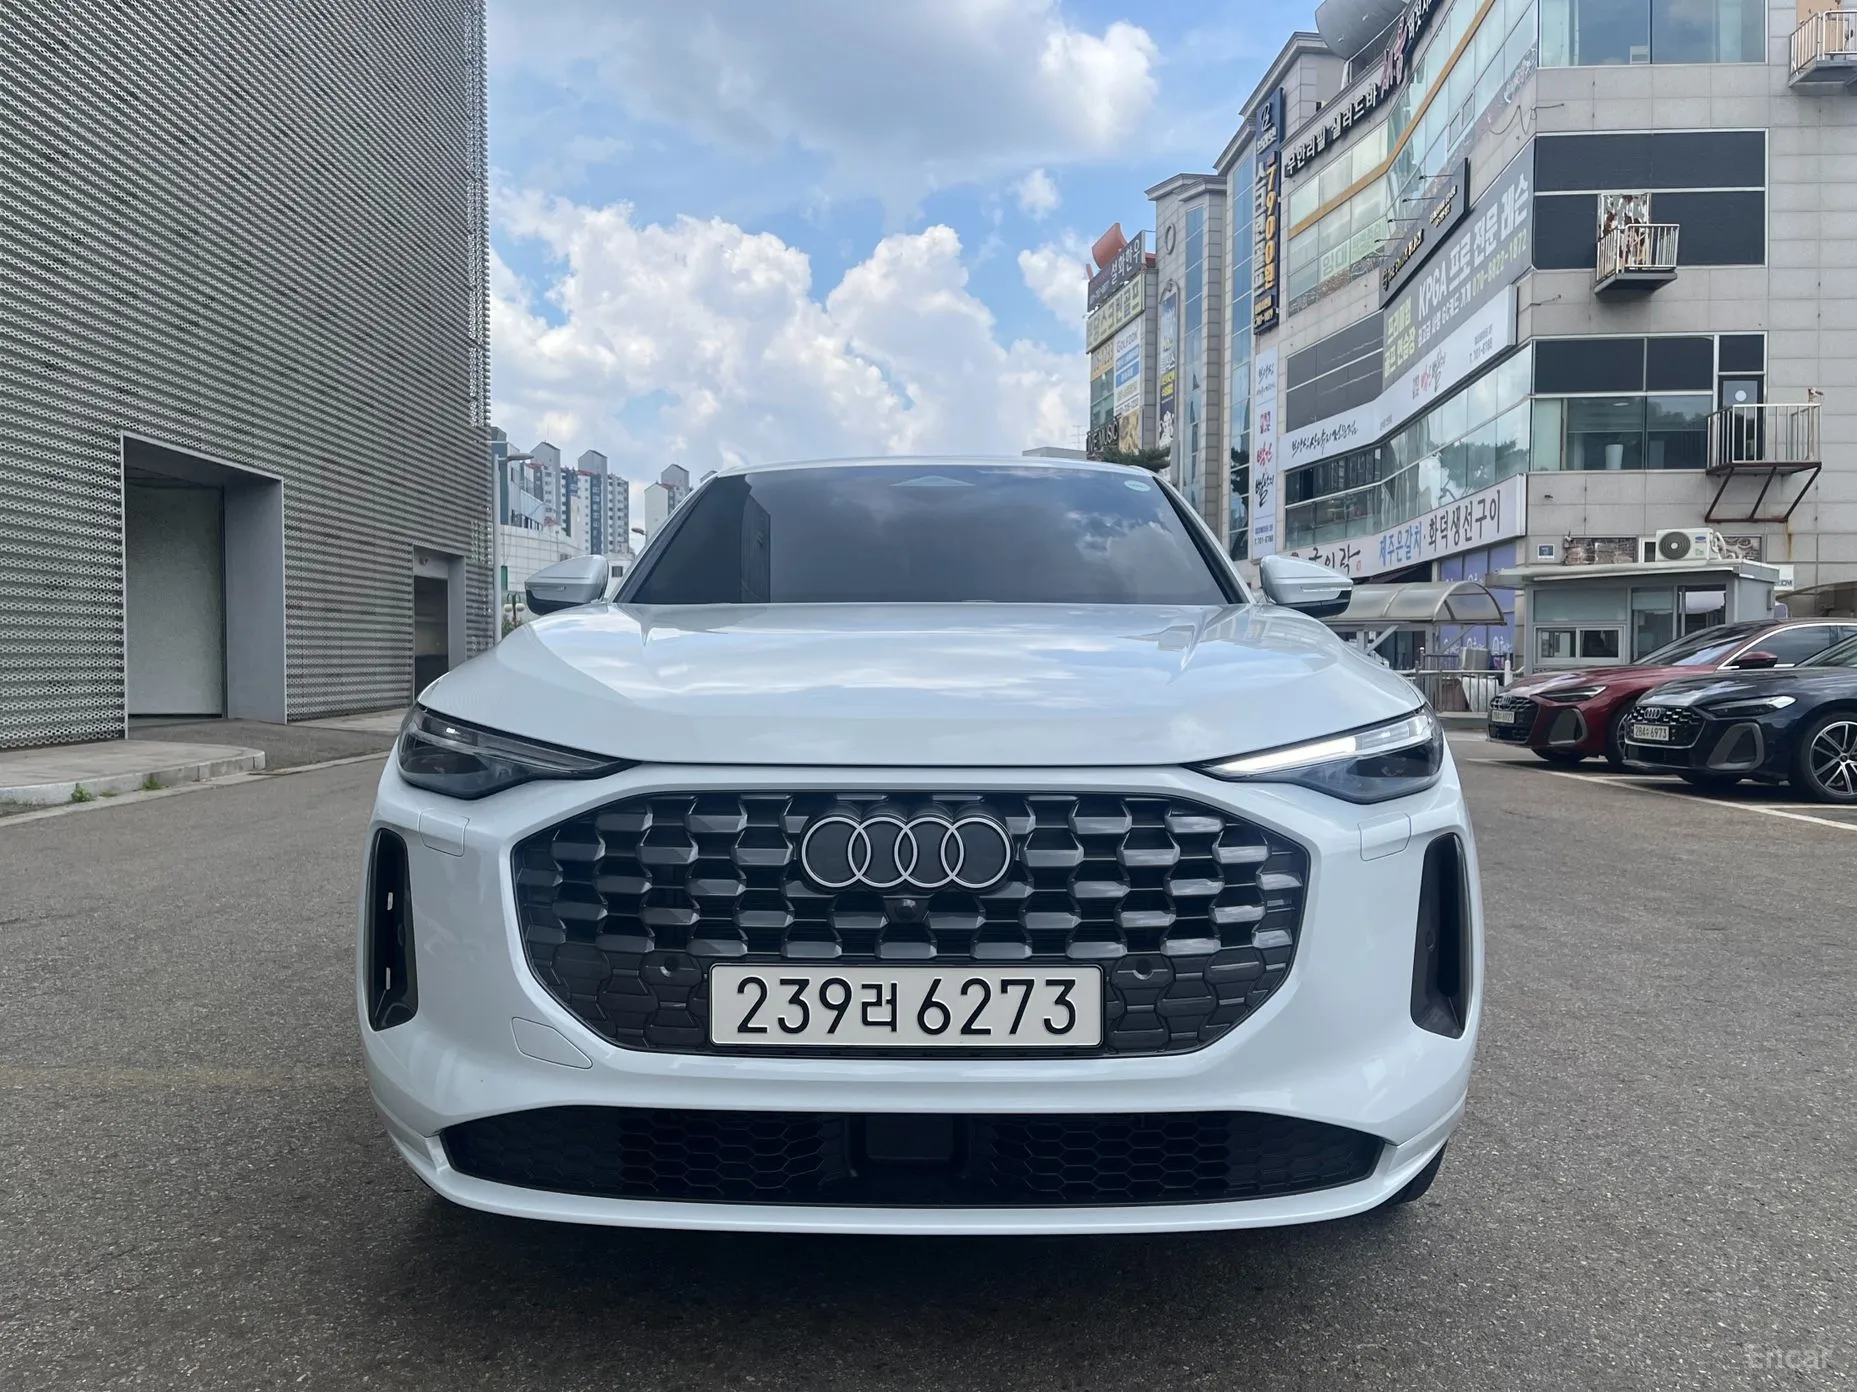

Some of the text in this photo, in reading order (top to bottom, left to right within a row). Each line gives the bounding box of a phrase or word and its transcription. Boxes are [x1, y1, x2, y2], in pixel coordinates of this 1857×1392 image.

[1287, 126, 1326, 175] 무한리필
[1330, 82, 1377, 140] 샐러드바
[1110, 239, 1140, 285] 설화한우
[1418, 260, 1447, 321] KPGA
[1449, 232, 1471, 291] 프로
[1473, 202, 1498, 267] 전문
[1500, 172, 1529, 241] 레슨
[737, 976, 1076, 1036] 239러 6273
